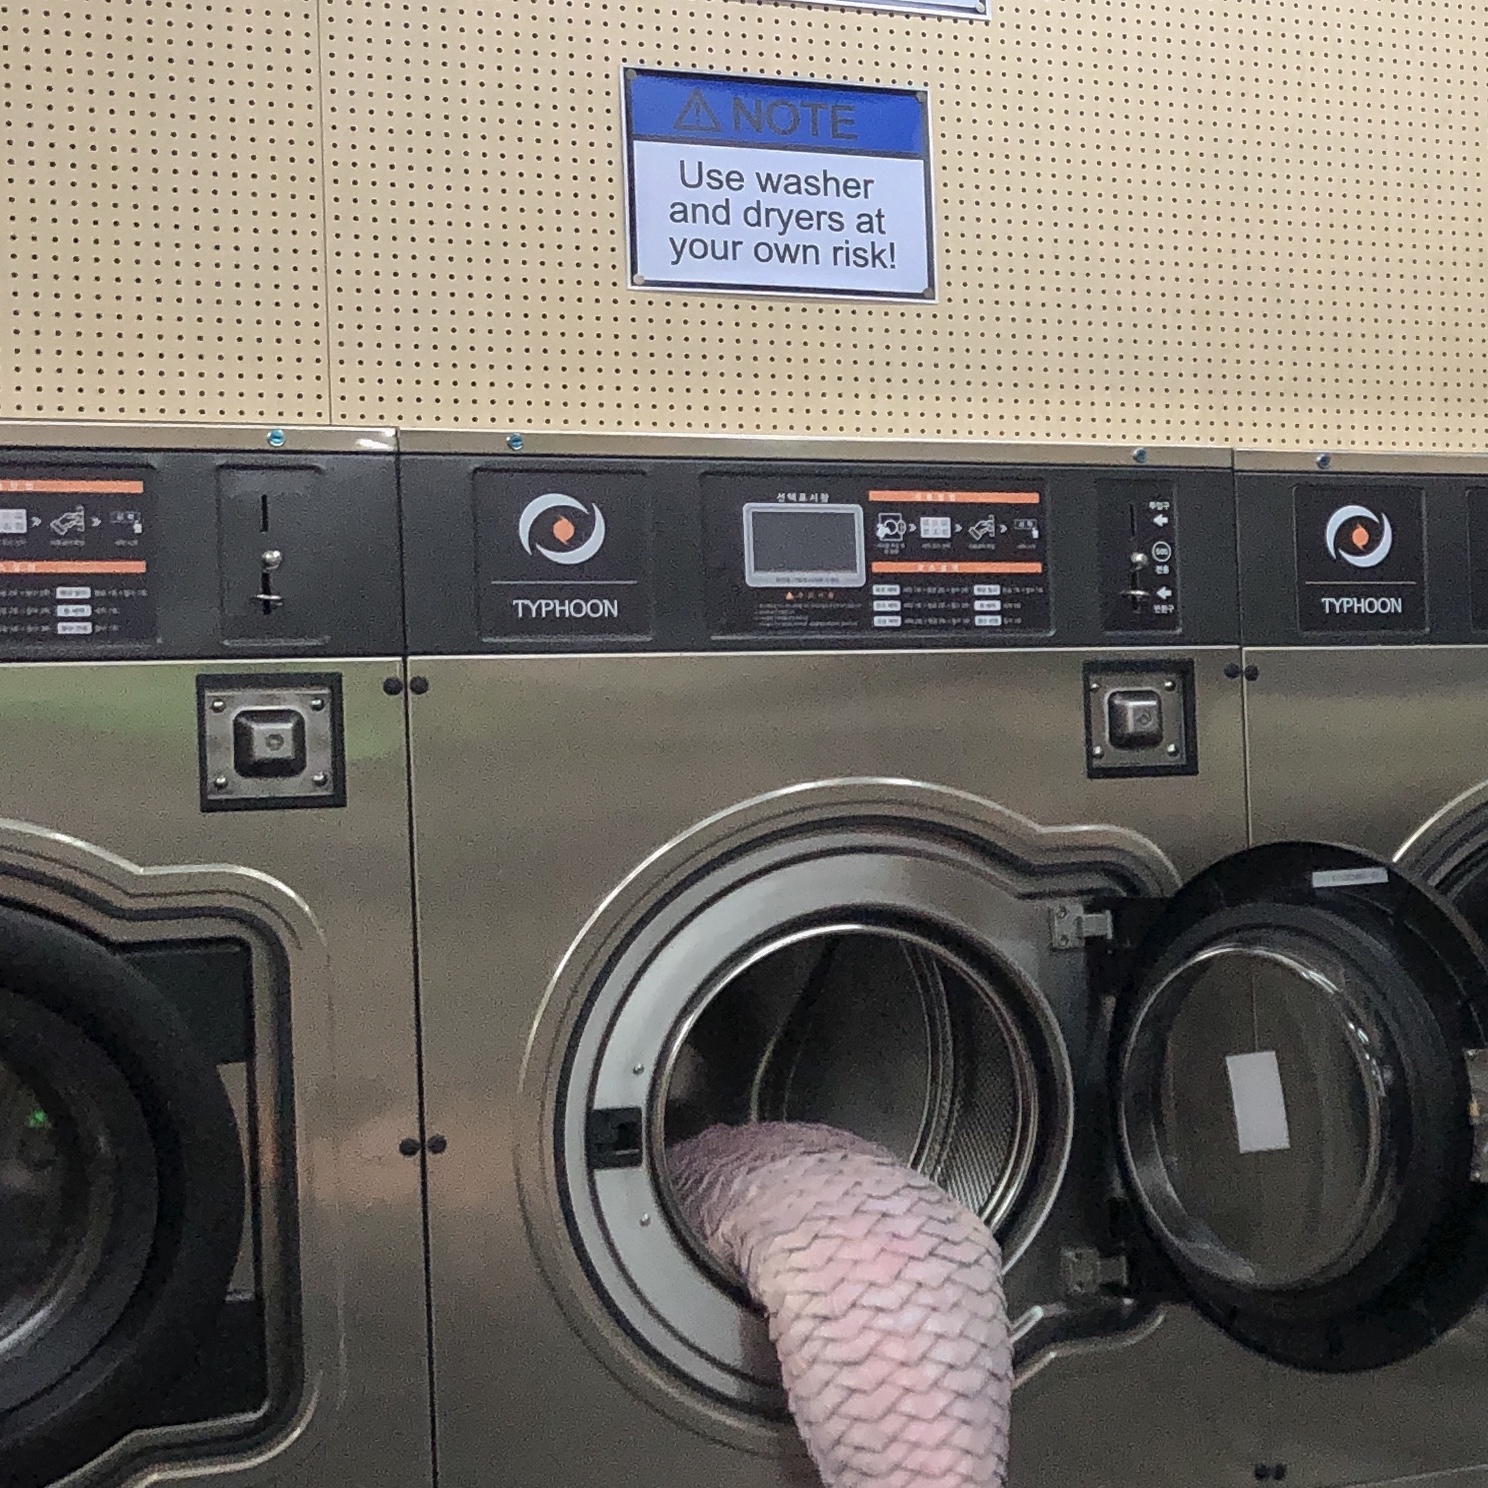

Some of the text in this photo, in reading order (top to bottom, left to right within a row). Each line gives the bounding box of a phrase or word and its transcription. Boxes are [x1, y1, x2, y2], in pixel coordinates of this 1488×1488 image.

[732, 97, 859, 140] NOTE
[678, 159, 875, 200] Use washer
[669, 197, 887, 236] and dryers at
[669, 236, 897, 269] your own risk!
[512, 599, 618, 618] TYPHOON
[1321, 597, 1402, 614] TYPHOON
